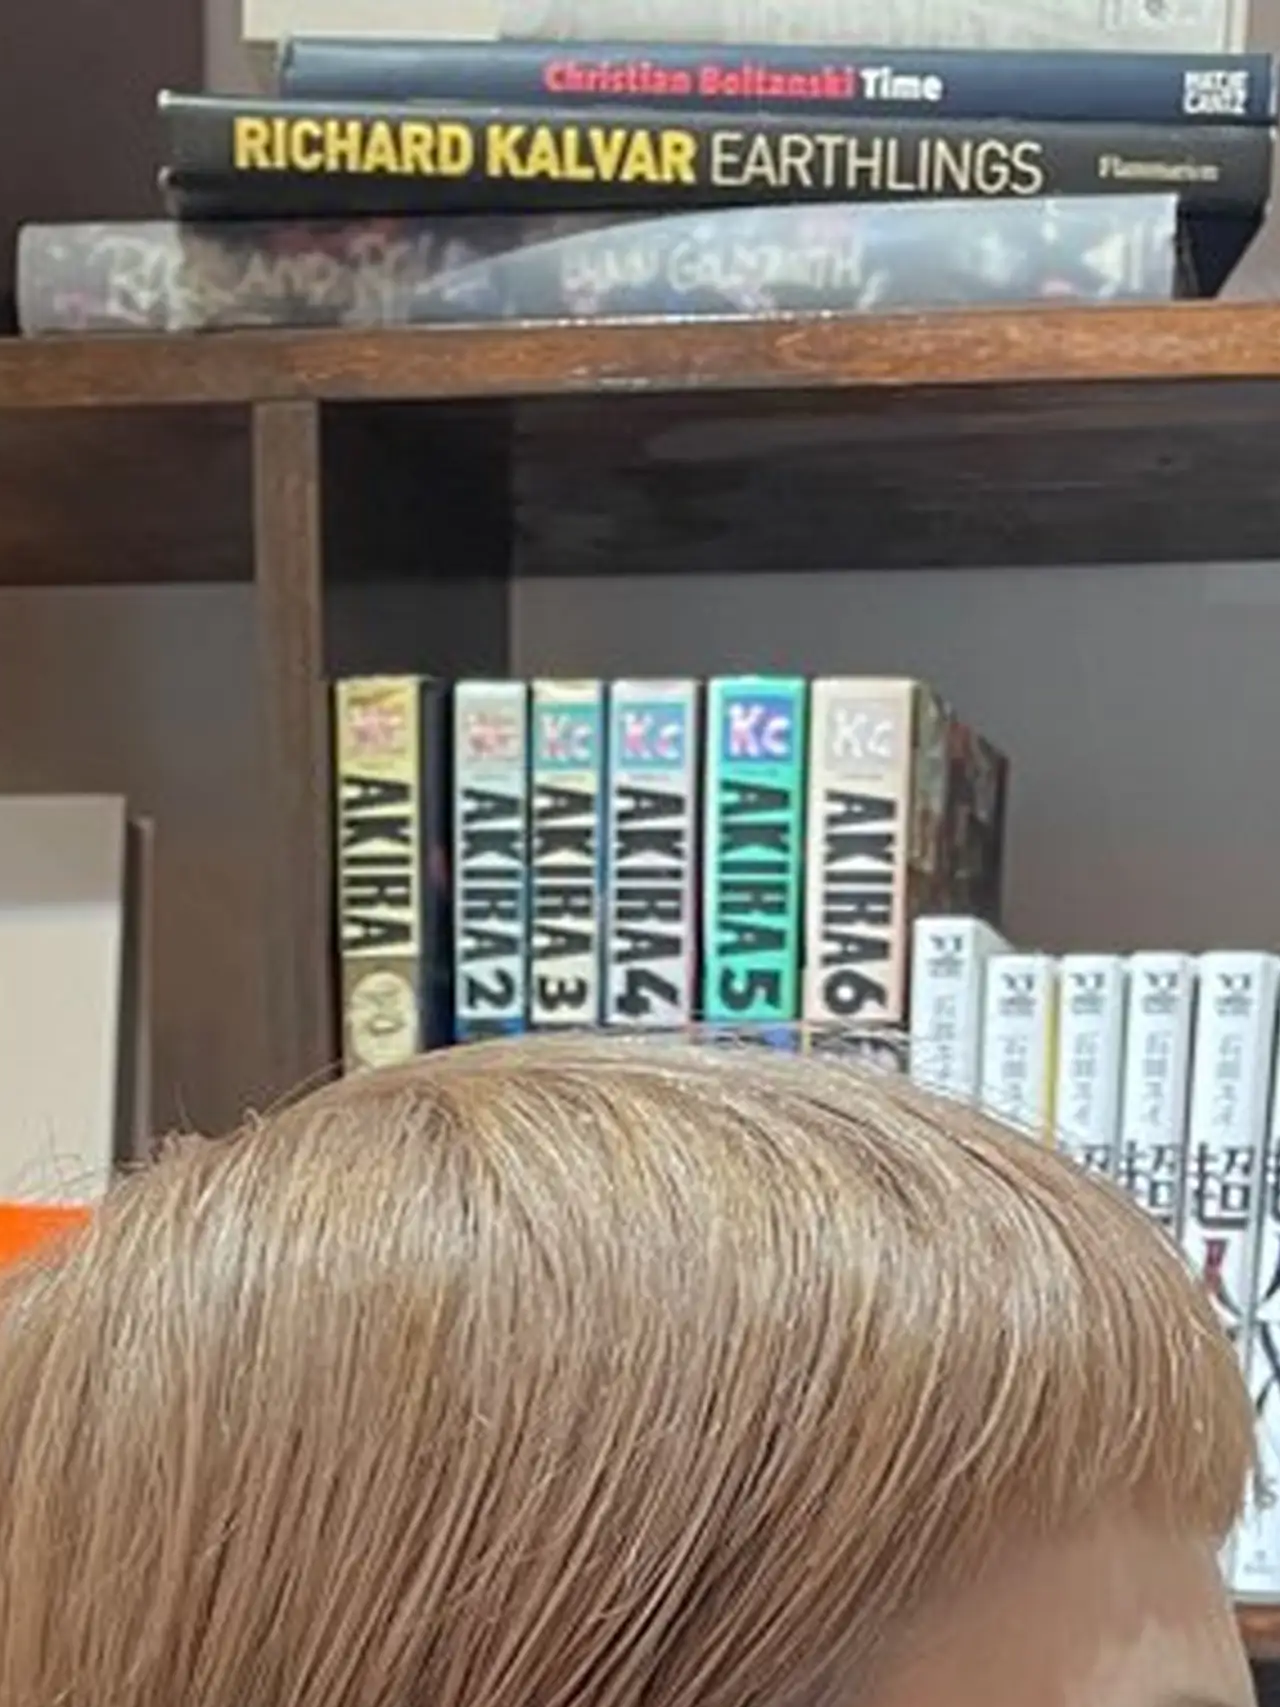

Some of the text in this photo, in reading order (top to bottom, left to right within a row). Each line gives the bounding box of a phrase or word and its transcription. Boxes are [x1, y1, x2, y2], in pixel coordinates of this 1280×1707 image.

[232, 115, 1045, 195] RICHARD KALVAR EARTHLINGS
[544, 63, 944, 102] Christian Boltanski Time
[342, 774, 413, 954] AKIRA
[460, 786, 524, 964] AKIRA
[534, 783, 599, 1011] AKIRA 3
[611, 786, 687, 1016] AKIRA 4
[719, 778, 793, 1014] AKIRA 5
[823, 789, 896, 1015] AKIRA 6
[465, 971, 517, 1014] 2
